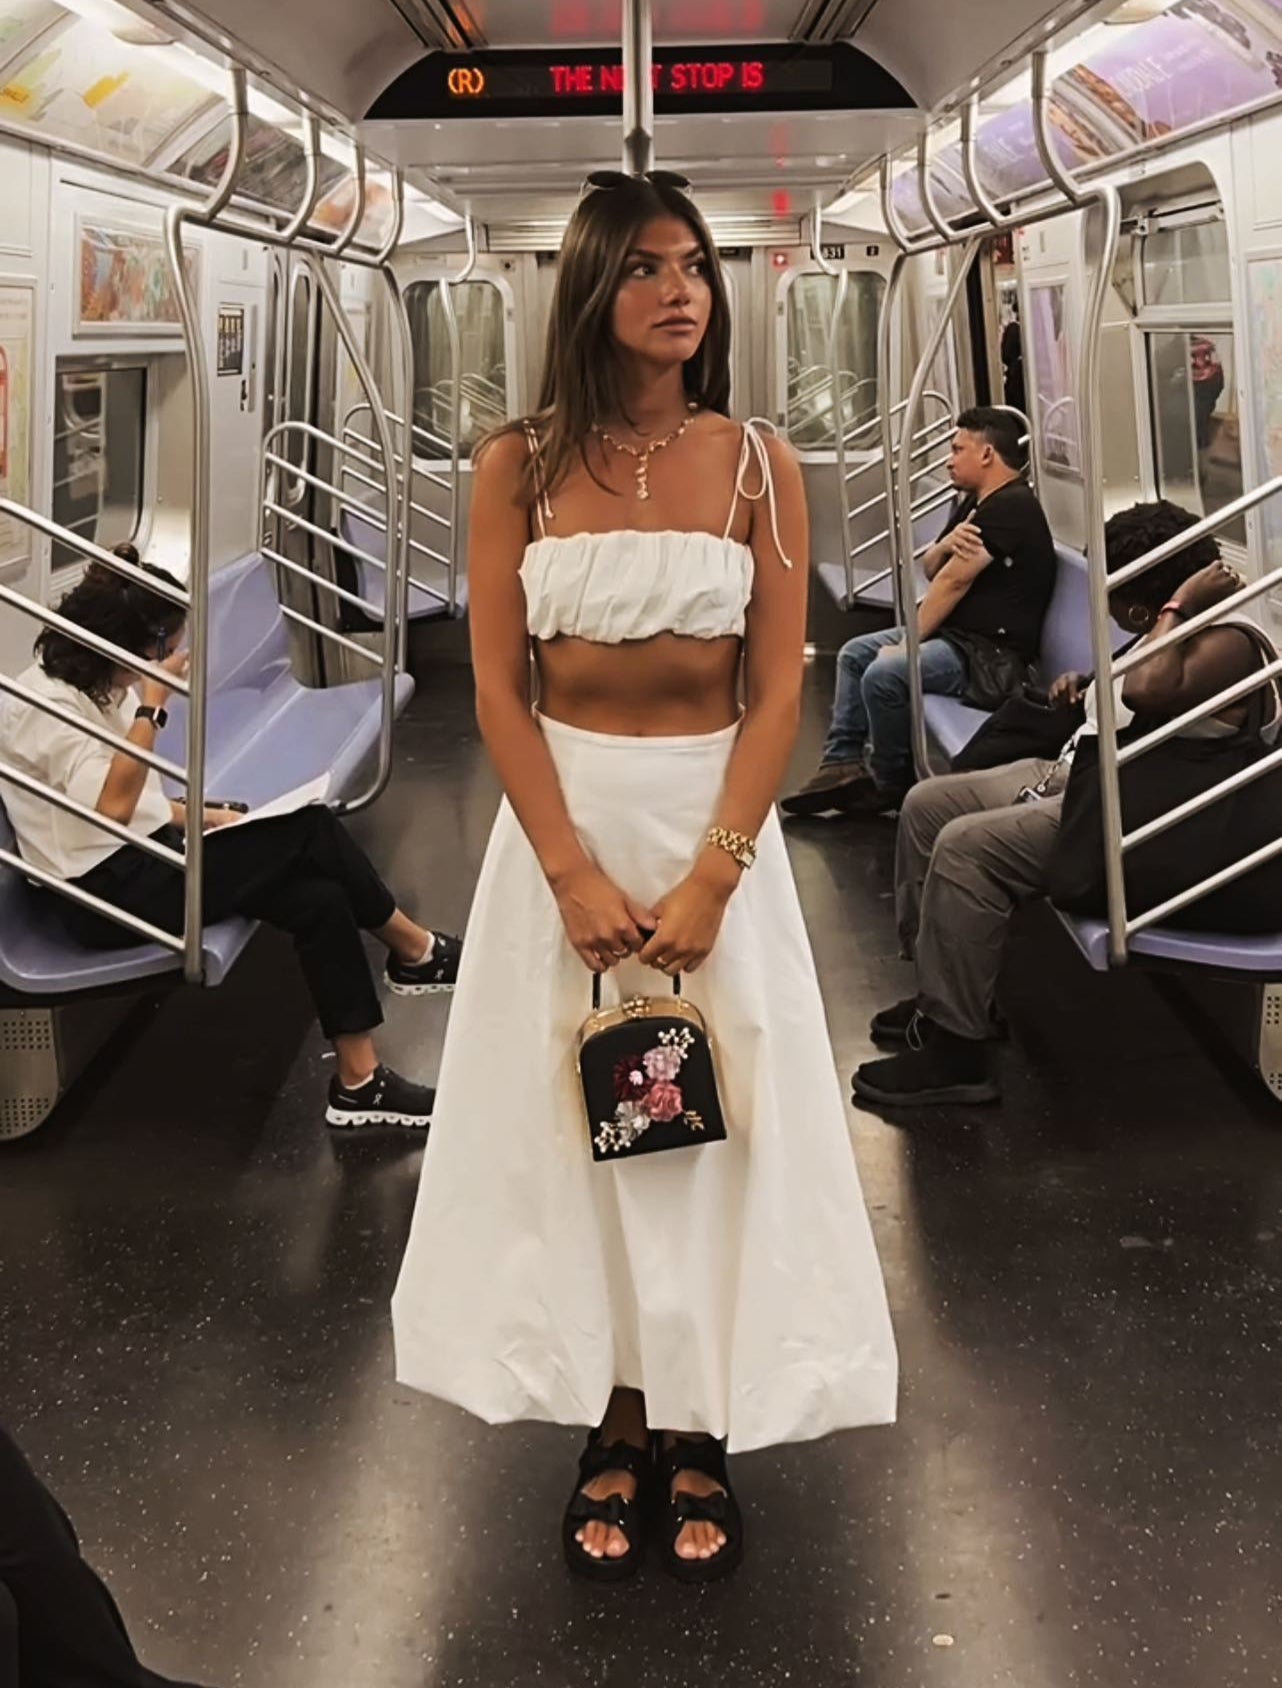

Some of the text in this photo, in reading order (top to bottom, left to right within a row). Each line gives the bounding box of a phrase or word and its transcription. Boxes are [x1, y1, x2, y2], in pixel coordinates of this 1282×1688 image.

[448, 68, 484, 94] (R)
[549, 66, 593, 92] THE
[671, 62, 735, 91] STOP
[742, 61, 764, 89] IS
